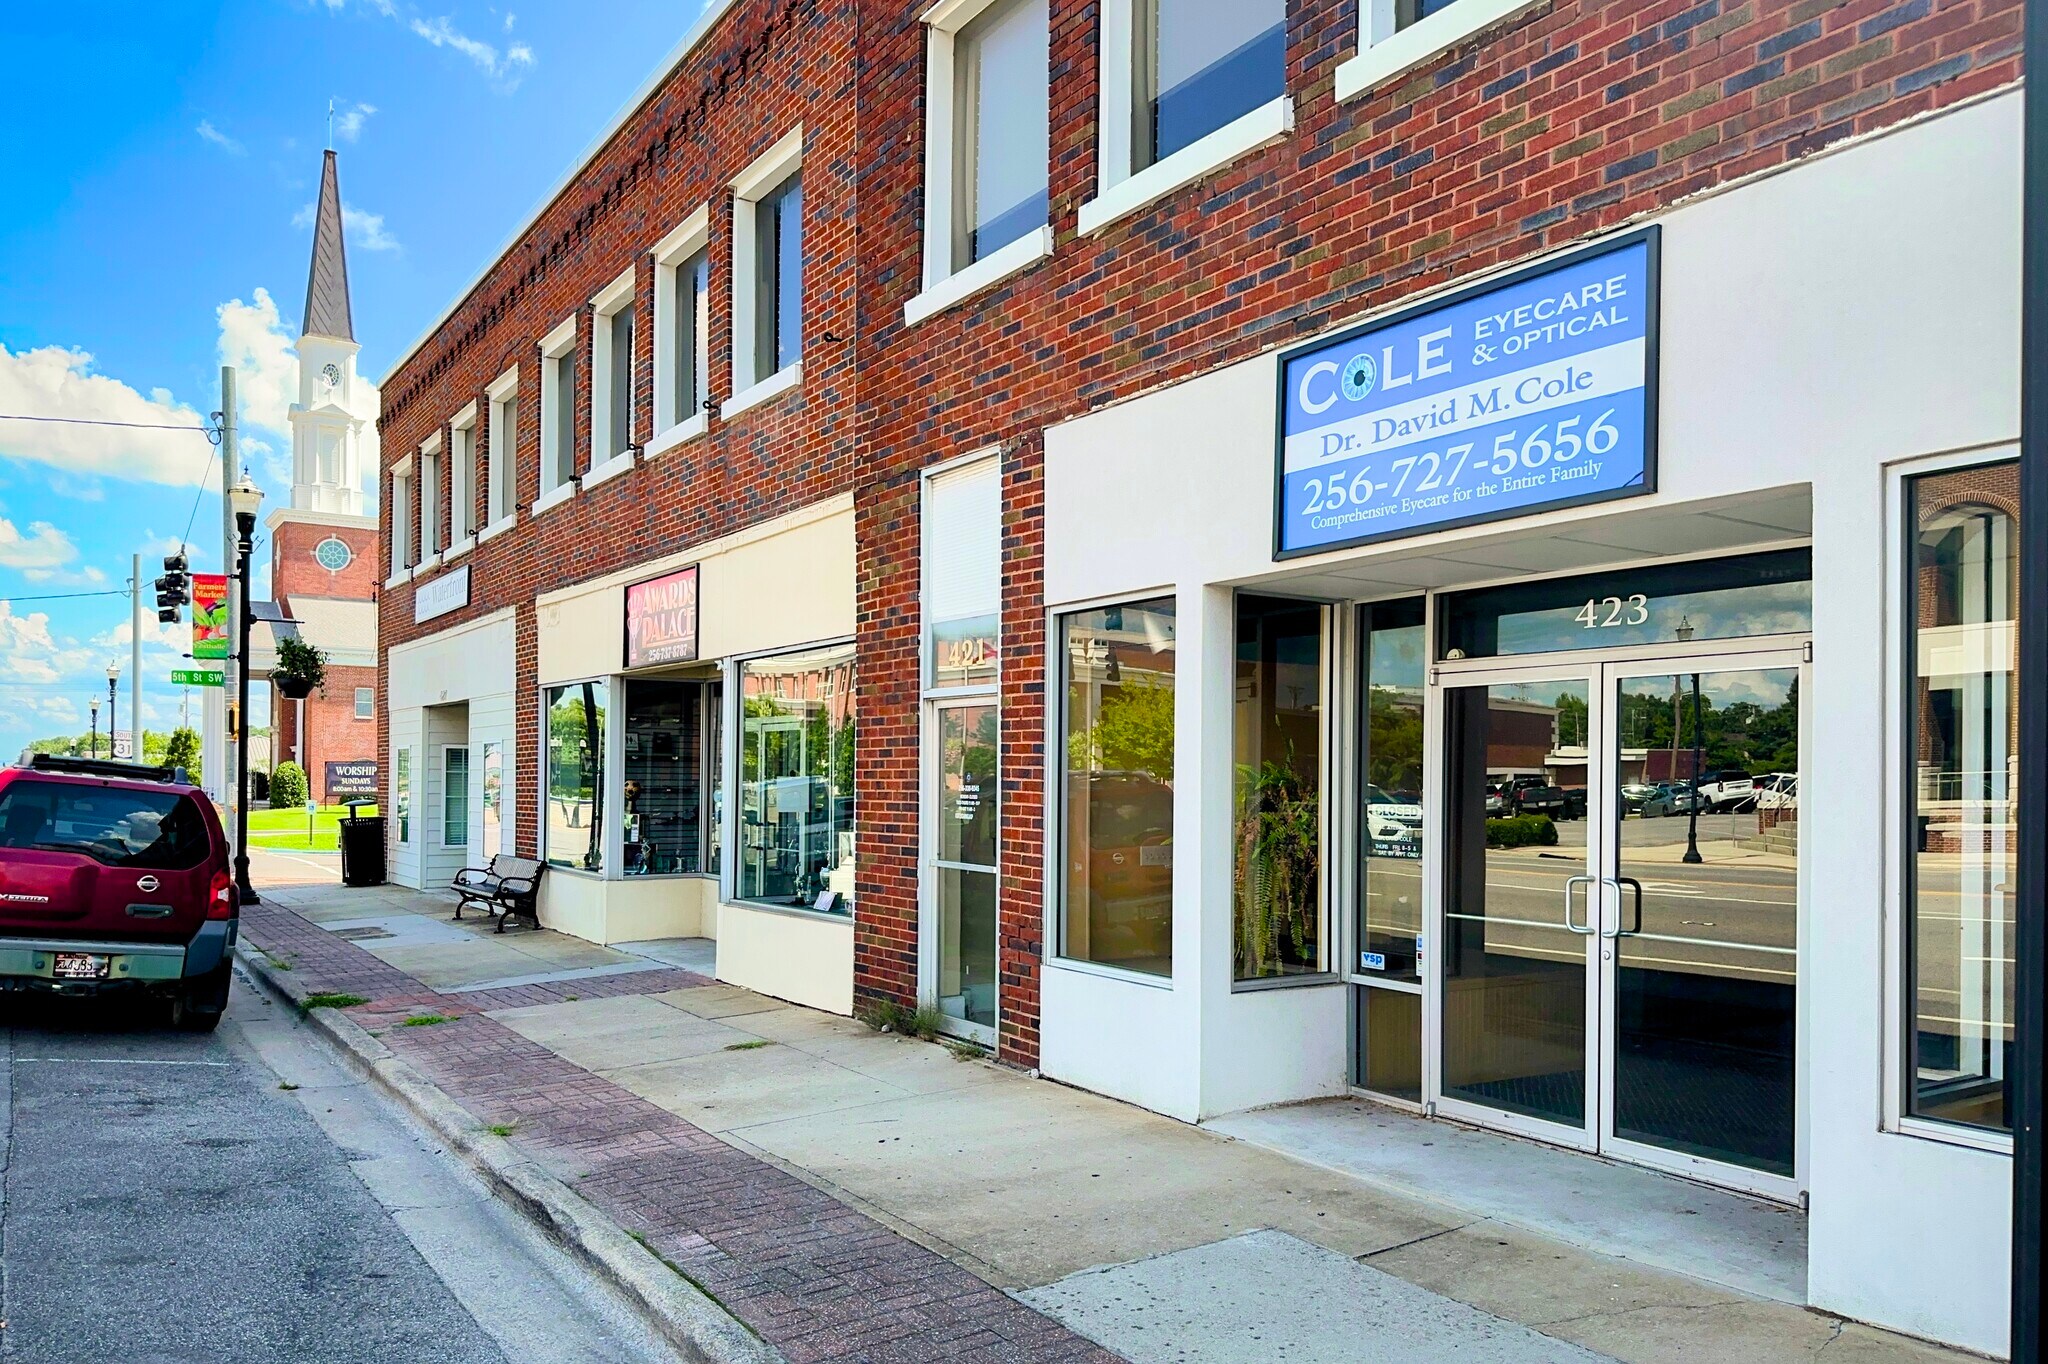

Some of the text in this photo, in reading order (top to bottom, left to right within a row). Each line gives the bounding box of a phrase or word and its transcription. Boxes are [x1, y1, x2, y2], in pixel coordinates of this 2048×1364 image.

[1474, 273, 1627, 340] EYECARE
[1471, 305, 1628, 366] & OPTICAL
[1300, 324, 1452, 415] COLE
[1319, 432, 1362, 458] Dr.
[1371, 399, 1457, 445] David
[1302, 407, 1619, 516] 256-727-5656
[1311, 458, 1603, 530] Comprehensive Eyecare for the Entire Family
[193, 582, 227, 591] Farmers
[195, 590, 225, 598] Market
[643, 576, 696, 614] AWARDS
[1574, 594, 1649, 629] 423
[642, 606, 695, 648] PALACE
[648, 644, 688, 661] 256-737-8787
[949, 638, 987, 667] 421
[172, 672, 223, 682] 5th St SW
[117, 743, 131, 754] 31
[335, 766, 378, 776] WORSHIP
[341, 777, 371, 785] SUNDAYS
[1375, 805, 1418, 817] CLOSED
[1363, 953, 1383, 965] vsp
